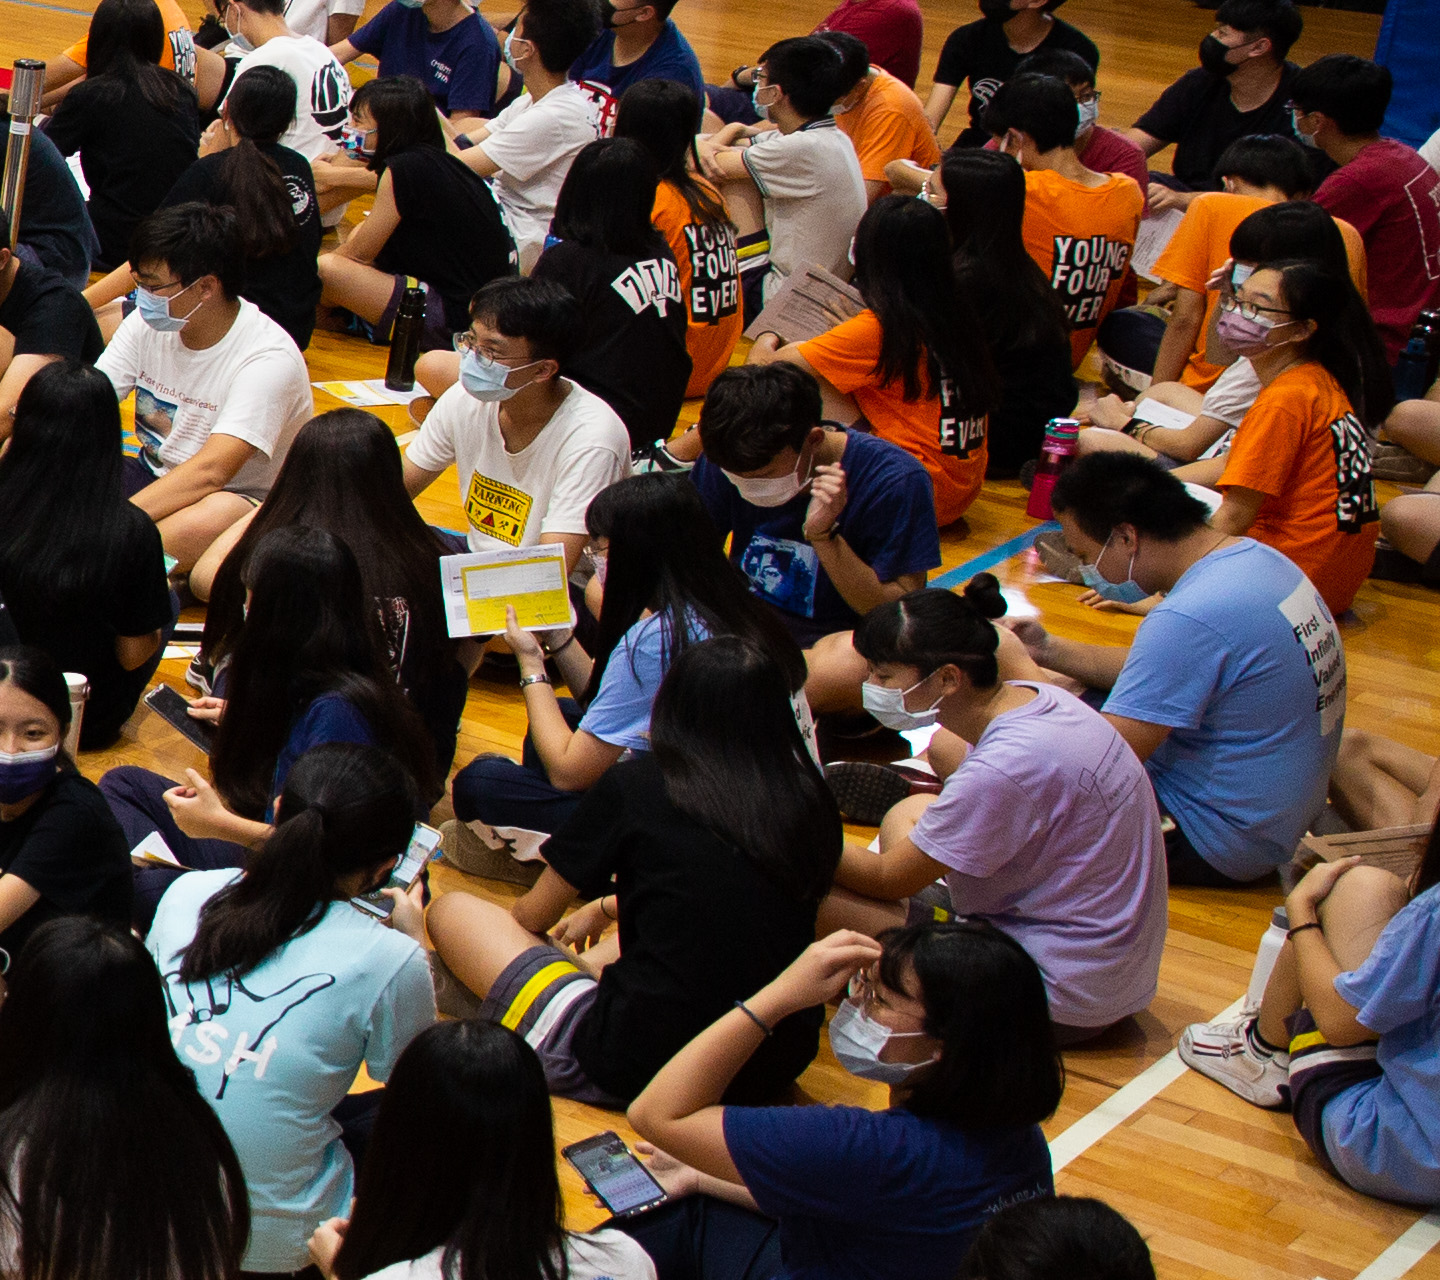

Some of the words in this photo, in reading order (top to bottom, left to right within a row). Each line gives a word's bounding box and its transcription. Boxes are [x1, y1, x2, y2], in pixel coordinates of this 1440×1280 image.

[692, 242, 737, 280] FOUR
[1055, 236, 1129, 271] YOUNG
[1052, 264, 1111, 295] FOUR
[691, 279, 737, 316] EVER
[1063, 296, 1104, 322] VER
[472, 483, 523, 514] WARNING
